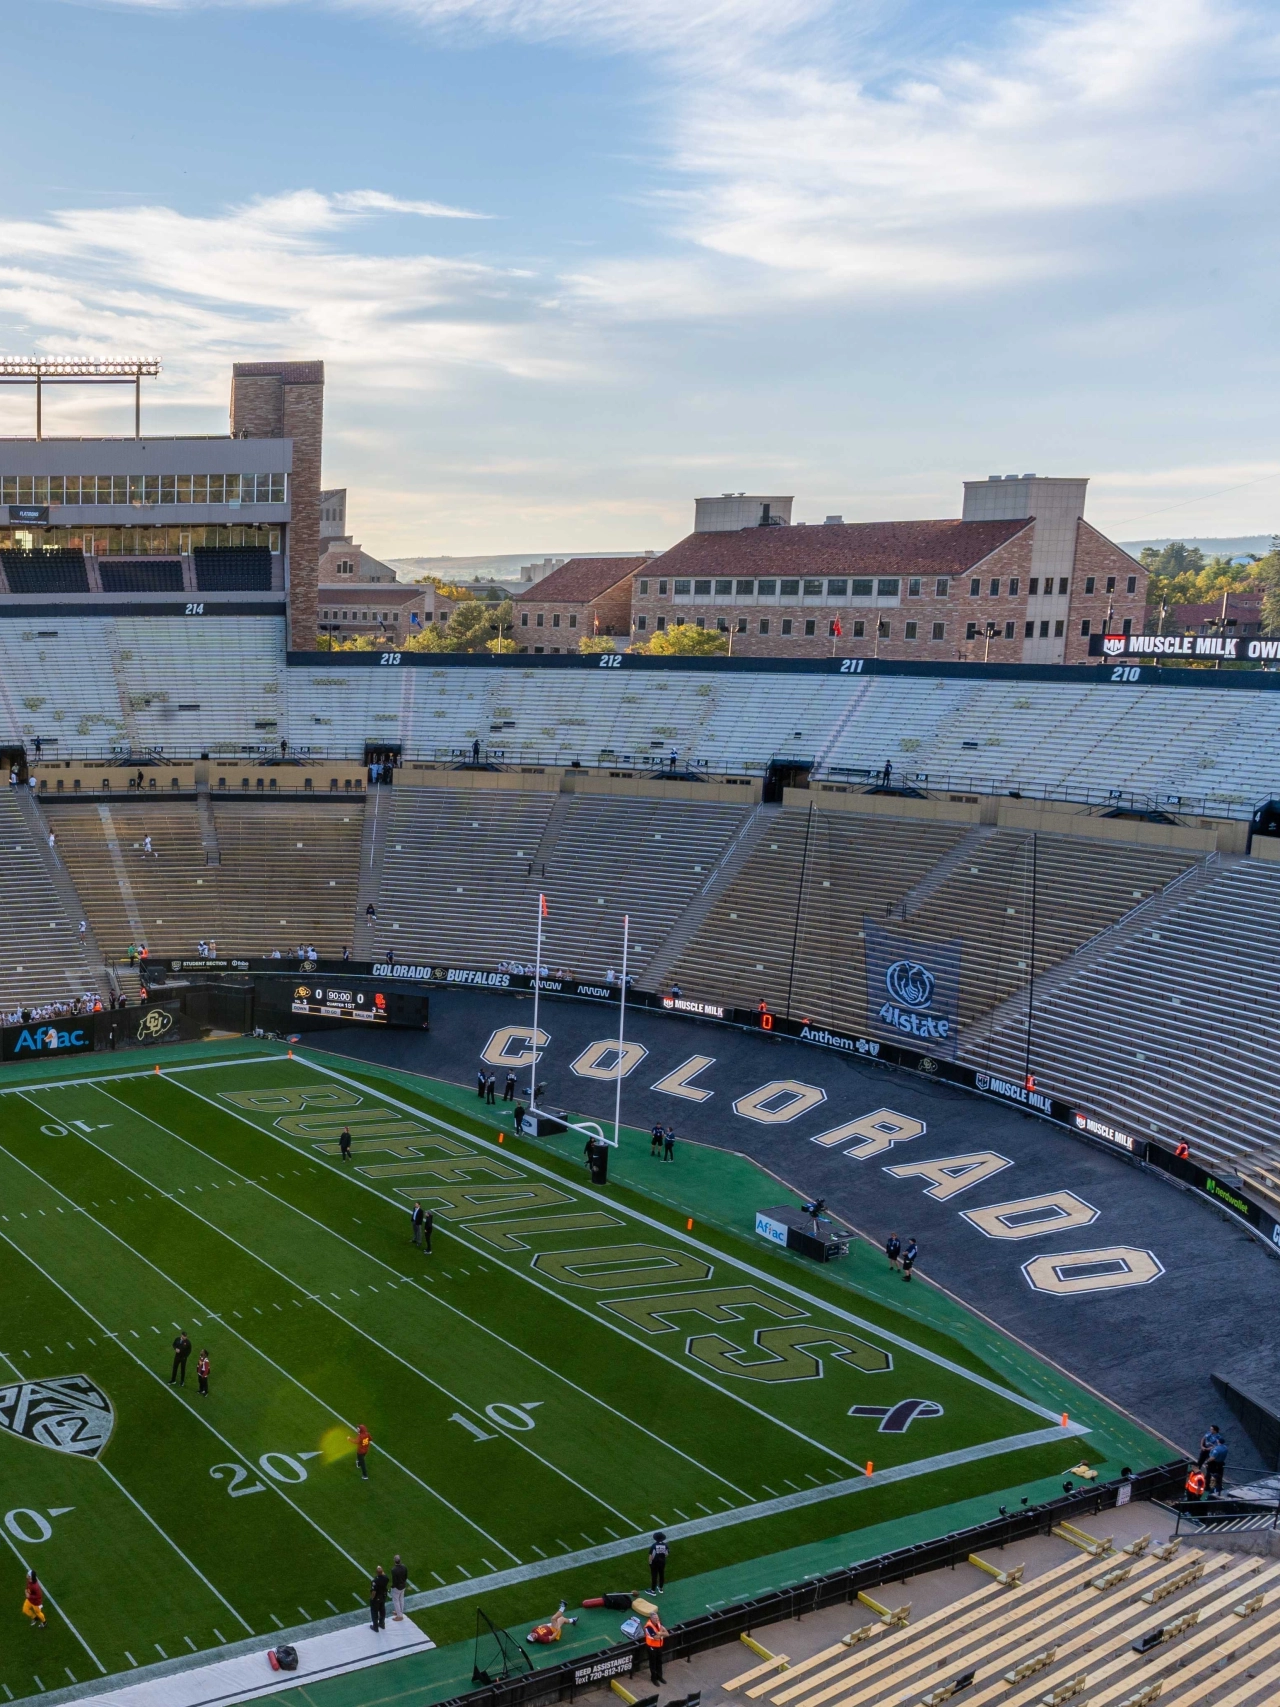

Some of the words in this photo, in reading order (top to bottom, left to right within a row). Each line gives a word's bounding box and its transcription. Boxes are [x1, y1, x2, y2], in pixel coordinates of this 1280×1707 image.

[185, 603, 204, 615] 214
[1129, 637, 1193, 653] MUSCLE
[1195, 638, 1237, 655] MILK
[380, 652, 401, 665] 213
[599, 654, 622, 667] 212
[839, 659, 864, 673] 211
[1111, 666, 1141, 682] 210
[372, 964, 431, 979] COLORADO
[446, 969, 510, 986] BUFFALOES
[316, 989, 322, 998] 0
[328, 991, 350, 1000] 90:00
[357, 994, 364, 1003] 0
[674, 1000, 702, 1014] MUSCLE
[703, 1003, 723, 1017] MILK
[763, 1015, 771, 1029] 0
[800, 1027, 854, 1050] Anthem
[990, 1078, 1026, 1102] MUSCLE
[1029, 1092, 1053, 1115] MILK
[40, 1119, 101, 1137] 10
[1087, 1119, 1114, 1141] MUSCLE
[1114, 1132, 1133, 1150] MILK
[480, 1025, 1166, 1295] COLORADO
[1215, 1186, 1248, 1214] nerdwallet
[218, 1084, 893, 1383] BUFFALOES
[41, 1416, 101, 1446] 12
[447, 1402, 535, 1444] 10
[209, 1452, 308, 1498] 20
[575, 1667, 591, 1677] NEED
[593, 1655, 633, 1672] ASSISTANCE?
[575, 1675, 589, 1685] Text
